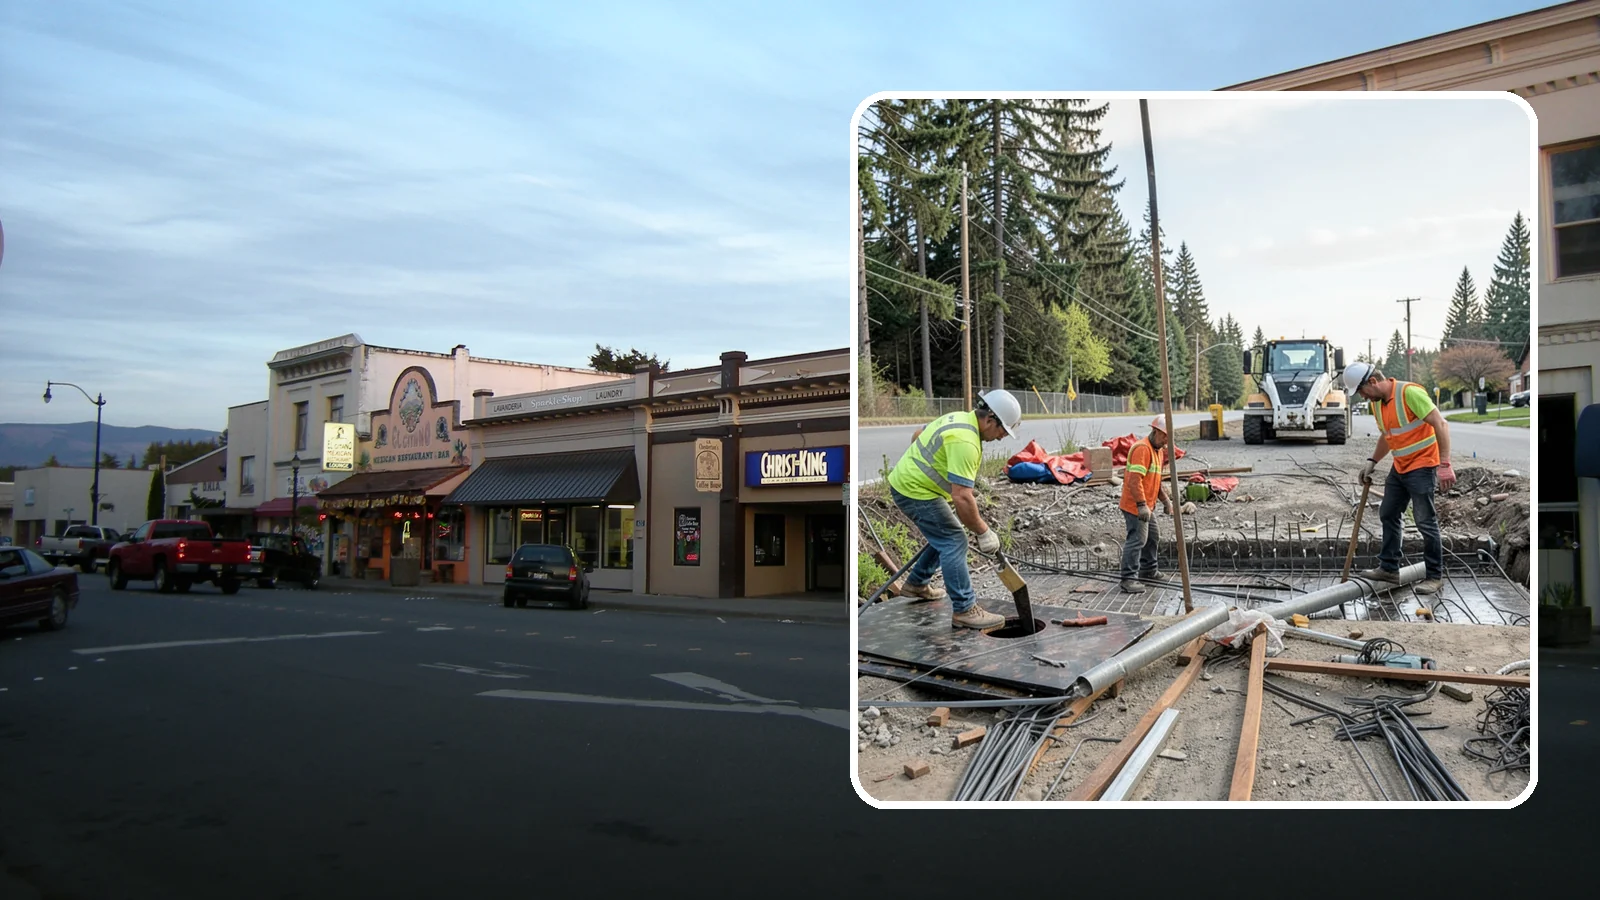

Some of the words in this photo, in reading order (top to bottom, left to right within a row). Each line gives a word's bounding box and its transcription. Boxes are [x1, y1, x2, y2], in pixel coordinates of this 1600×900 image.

[561, 394, 583, 404] Shop
[595, 389, 624, 400] LAUNDRY
[493, 402, 523, 413] LAVANDERIA
[373, 455, 396, 464] MEXICAN
[397, 451, 433, 462] RESTAURANT
[437, 450, 450, 459] BAR
[799, 450, 828, 476] KING
